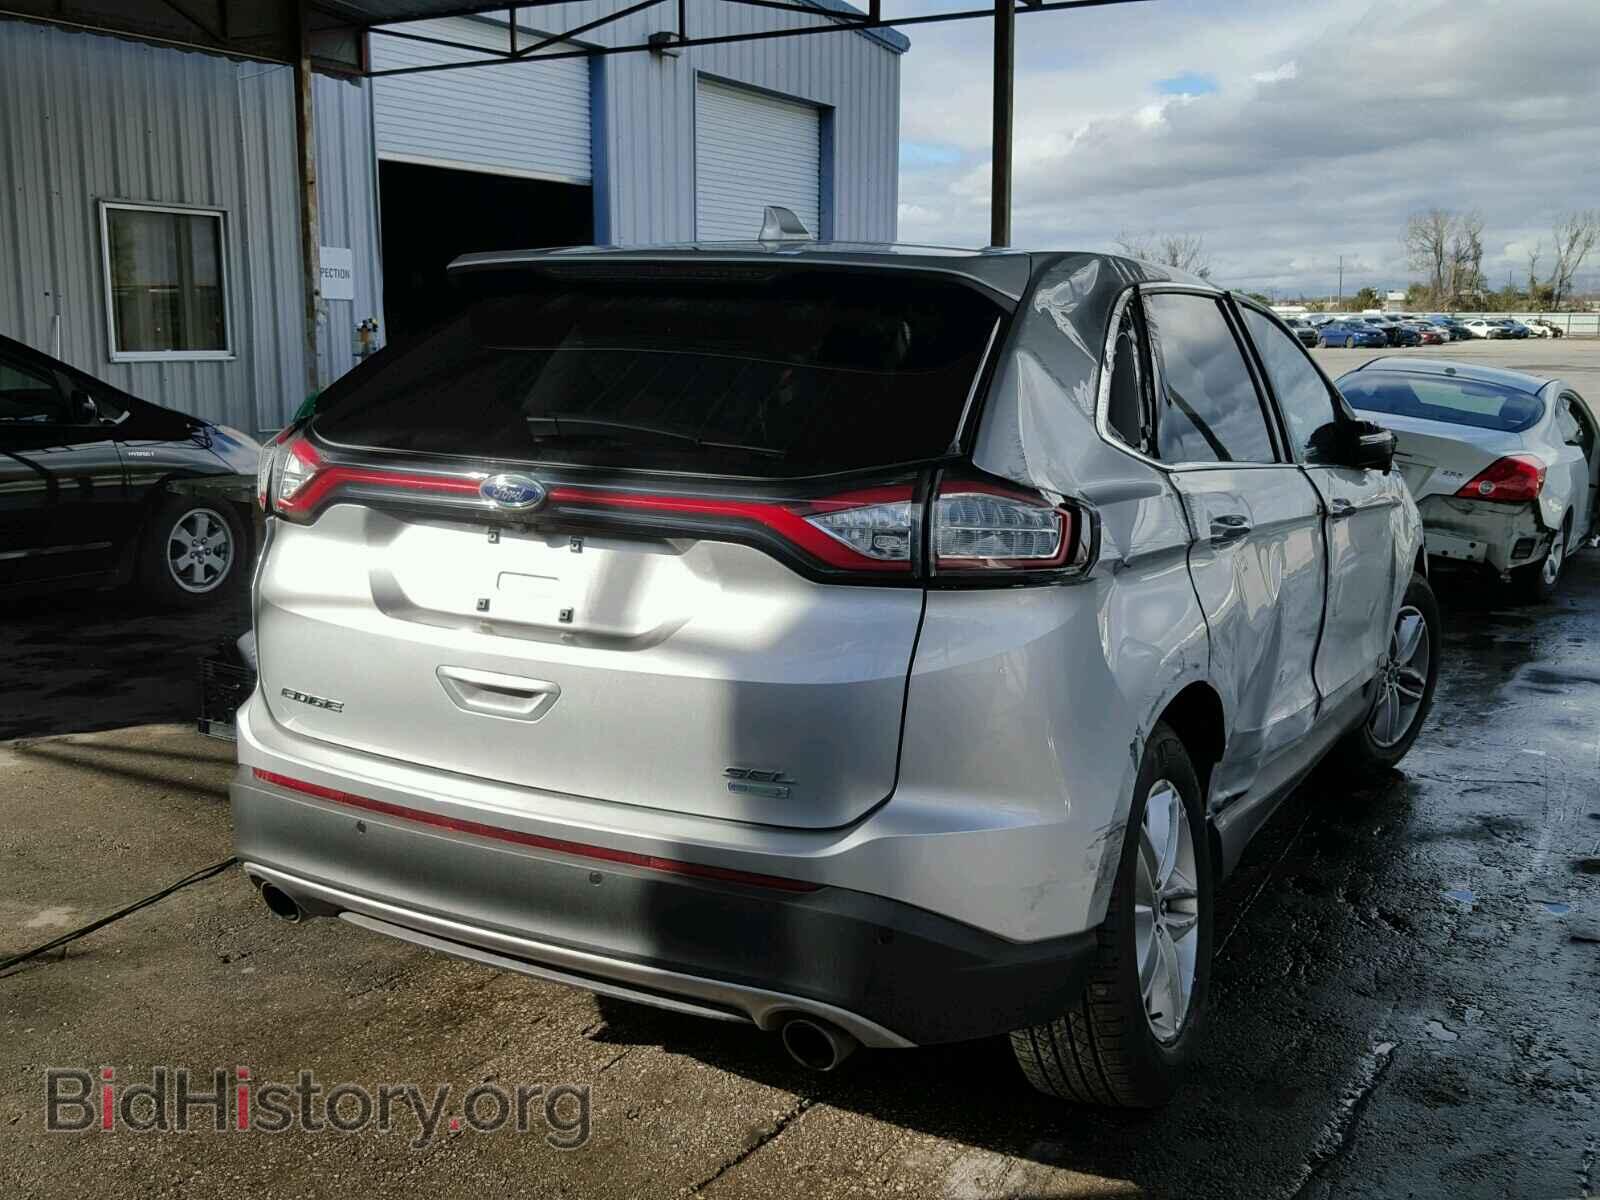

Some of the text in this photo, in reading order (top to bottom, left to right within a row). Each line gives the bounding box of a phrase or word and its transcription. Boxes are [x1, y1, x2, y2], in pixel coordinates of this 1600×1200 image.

[491, 485, 527, 501] Ford
[281, 688, 344, 712] EDGE
[722, 767, 796, 784] SEL
